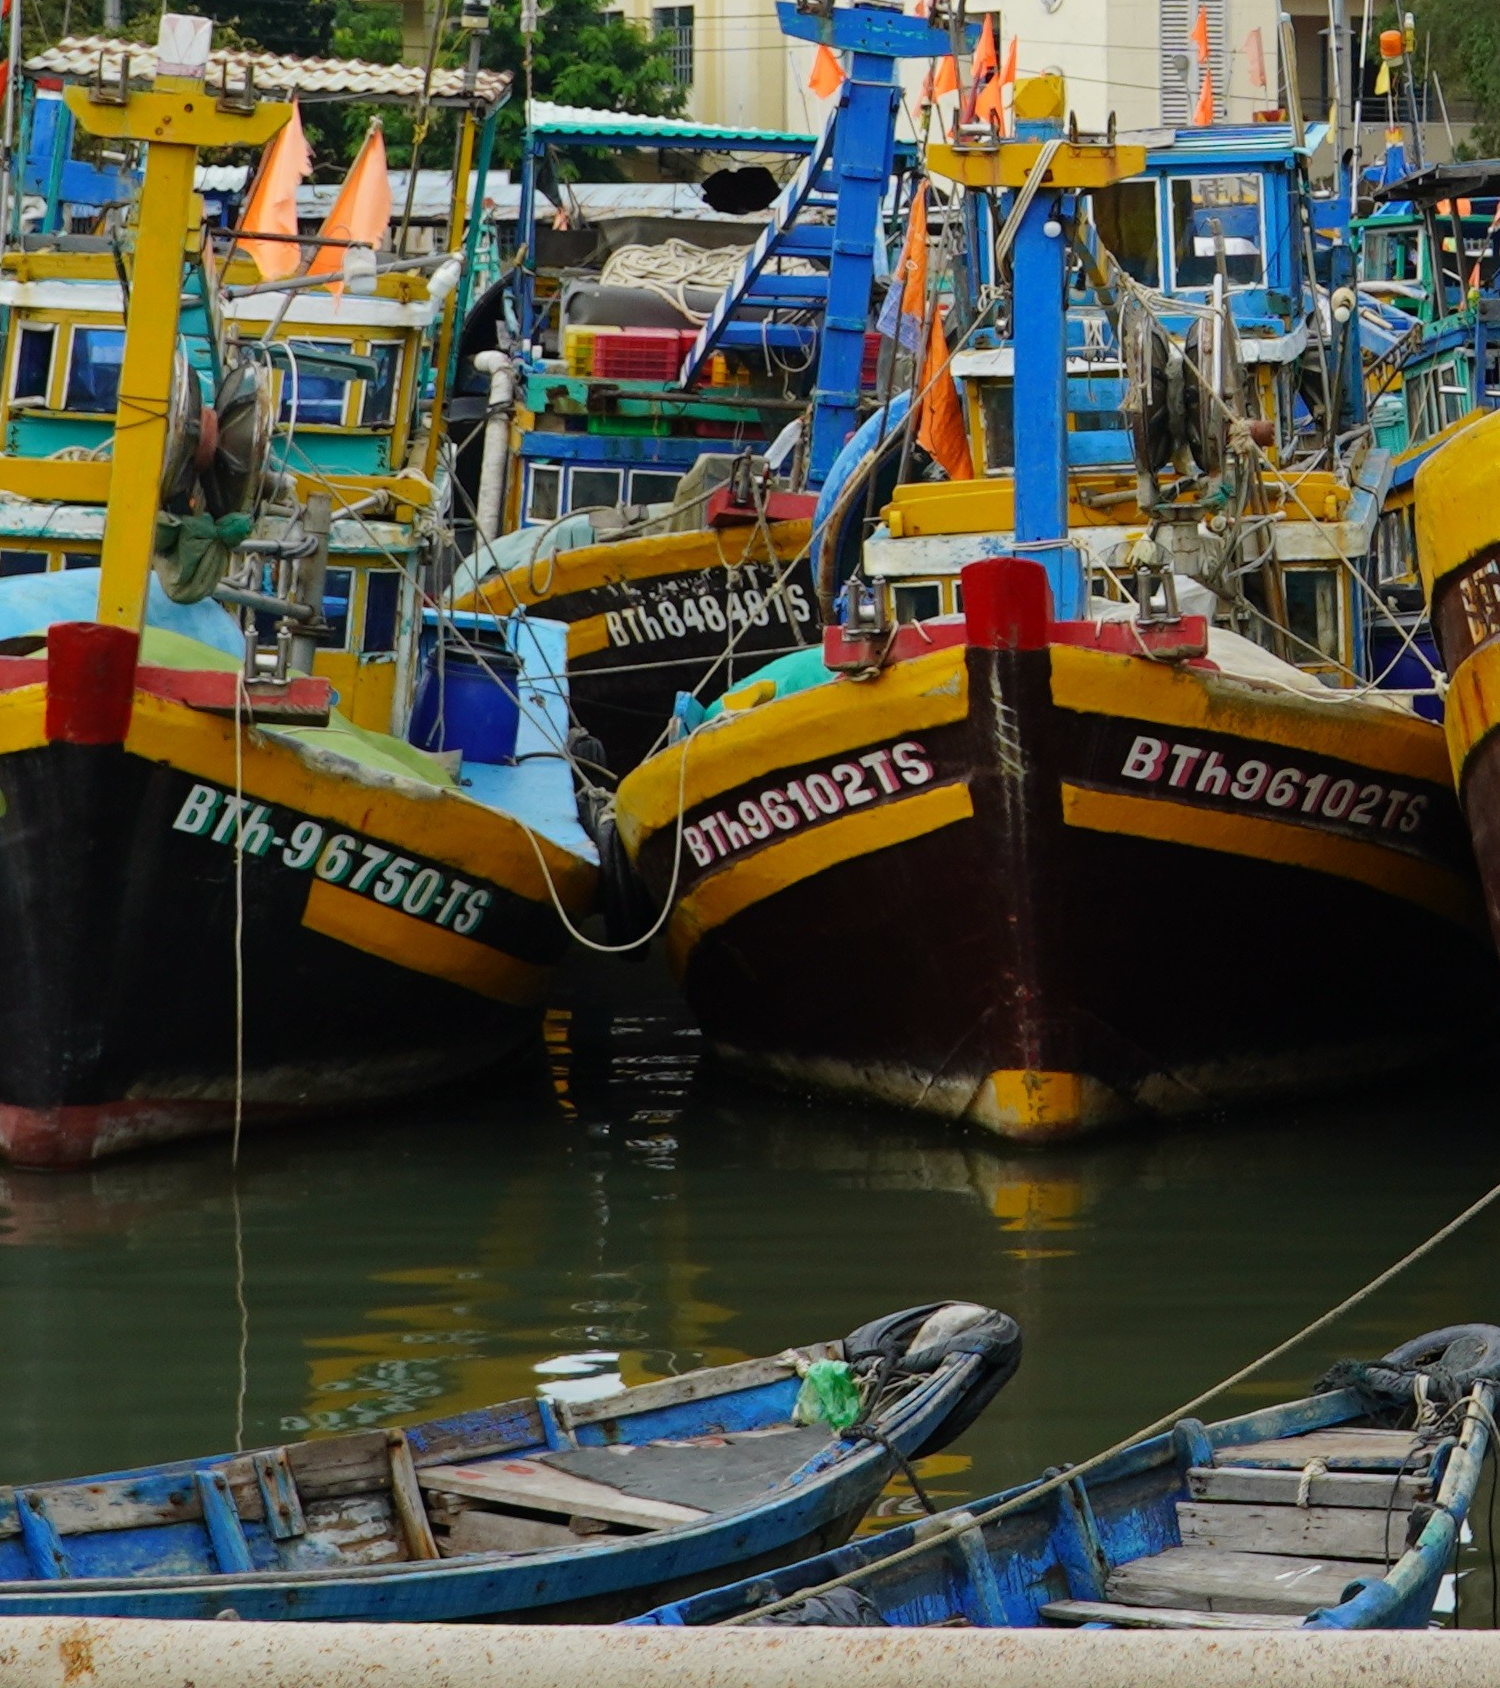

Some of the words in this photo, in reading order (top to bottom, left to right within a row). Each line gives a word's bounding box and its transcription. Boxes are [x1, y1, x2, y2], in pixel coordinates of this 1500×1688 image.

[683, 741, 934, 867] BTh96102TS
[1121, 735, 1430, 833] BTh96102TS
[172, 784, 493, 935] BTh-96750-TS
